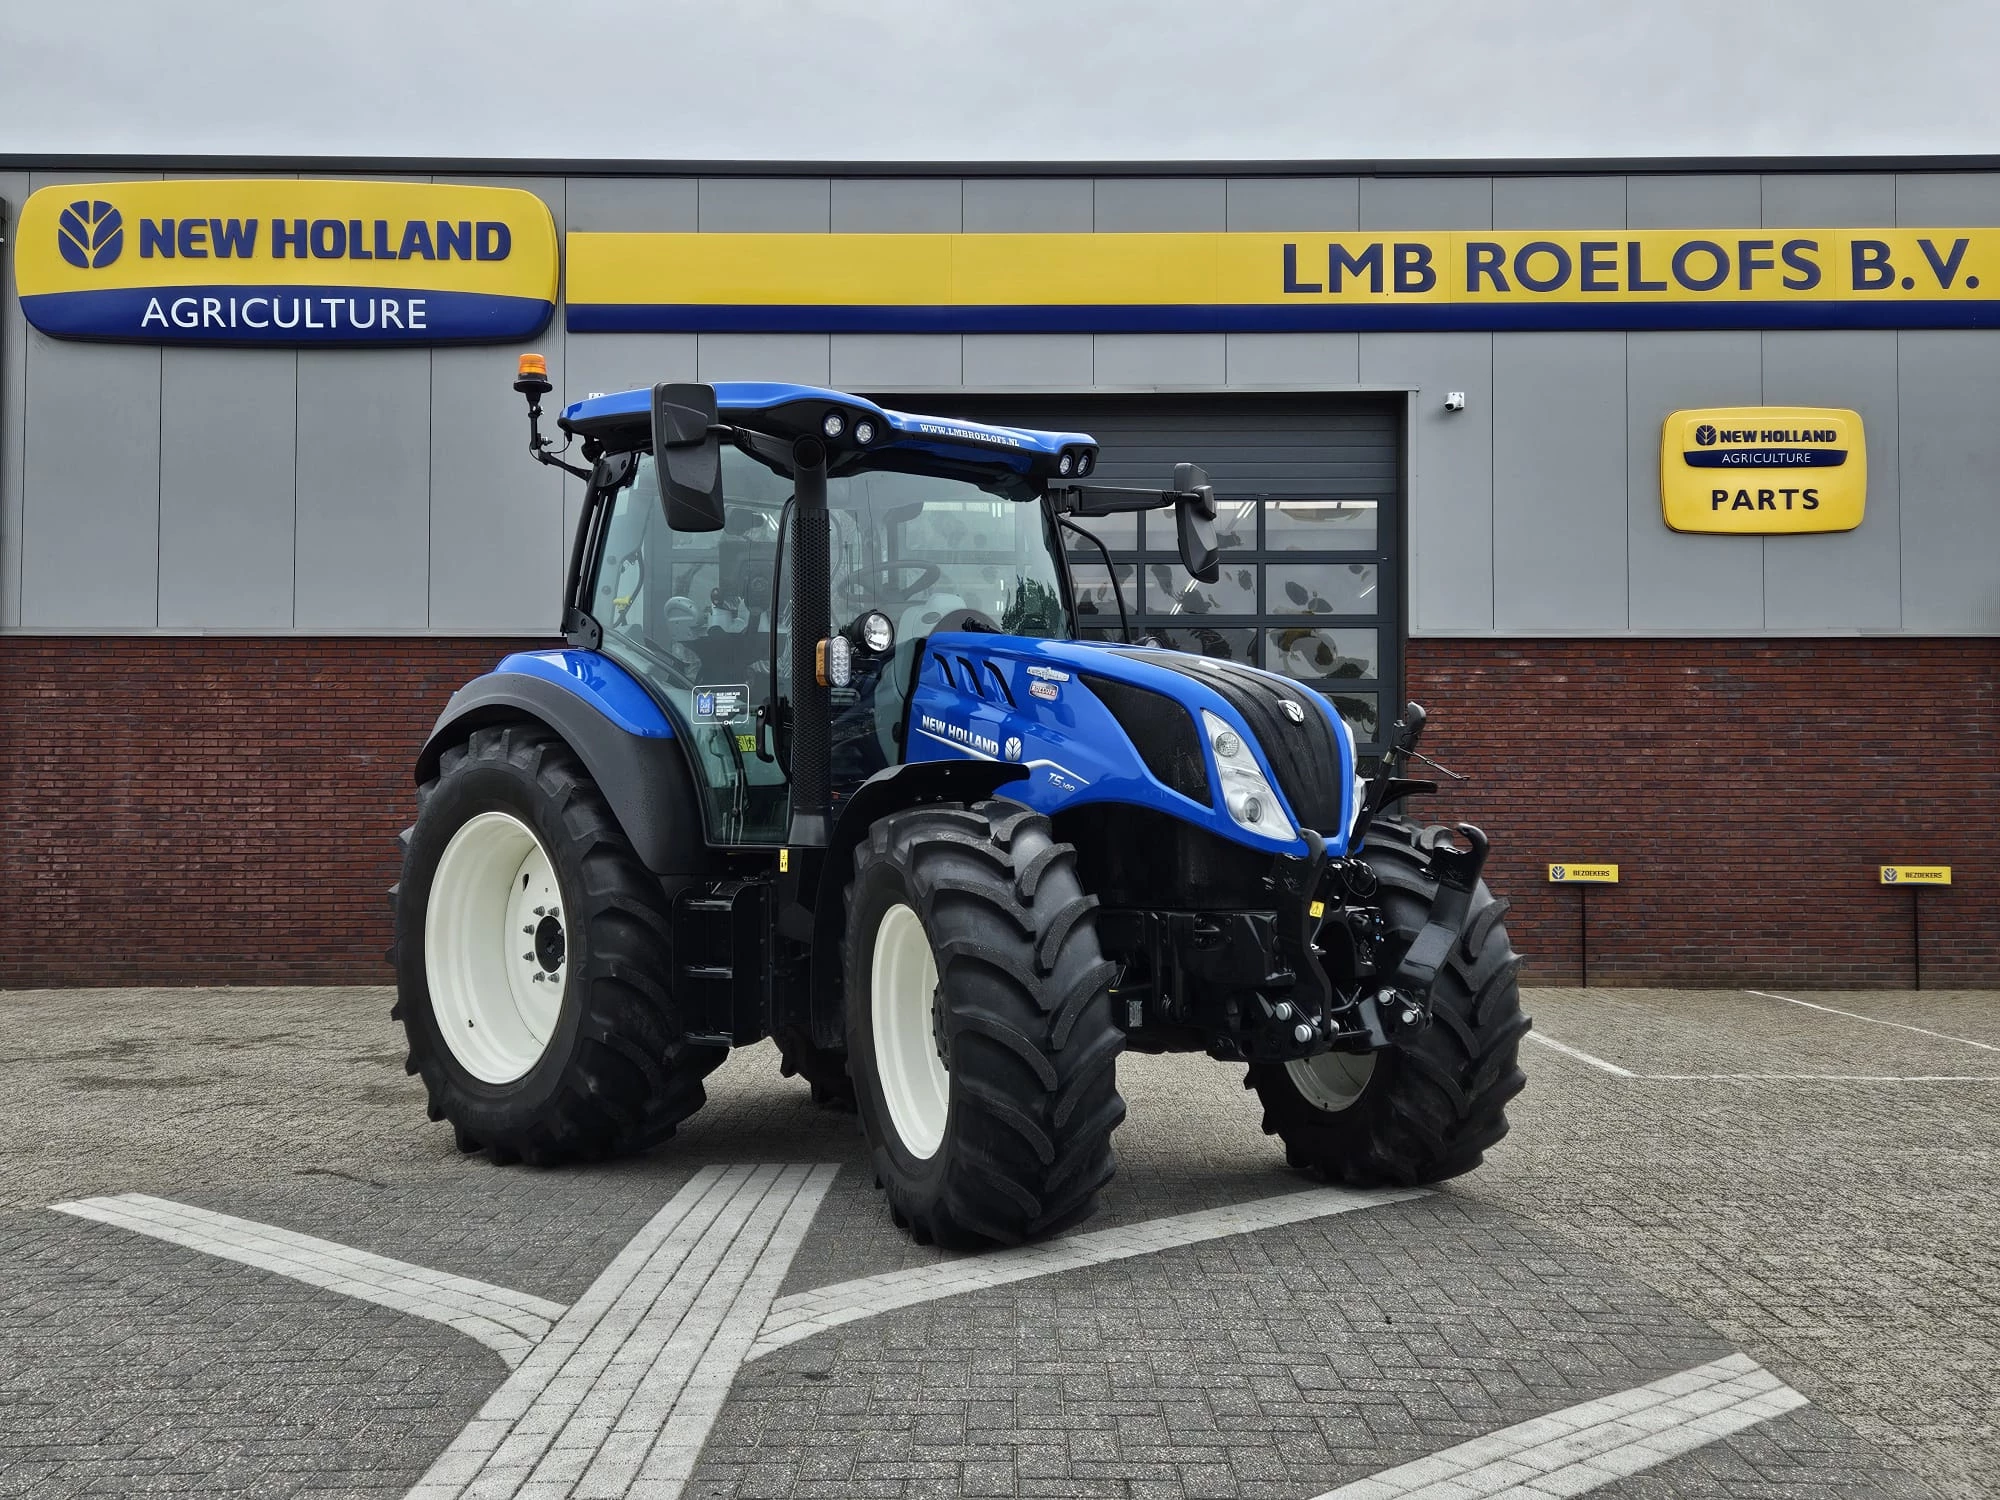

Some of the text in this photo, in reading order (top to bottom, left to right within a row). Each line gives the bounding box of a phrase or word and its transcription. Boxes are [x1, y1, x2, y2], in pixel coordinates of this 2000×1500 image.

[139, 218, 511, 261] NEW HOLLAND
[1283, 238, 1980, 294] LMB ROELOFS B.V.
[141, 297, 427, 329] AGRICULTURE
[919, 423, 1020, 447] WWW.LMBROELOFS.NL
[1720, 429, 1837, 443] NEW HOLLAND
[1721, 452, 1811, 464] AGRICULTURE
[1711, 488, 1820, 511] PARTS
[922, 714, 999, 756] NEW HOLLAND
